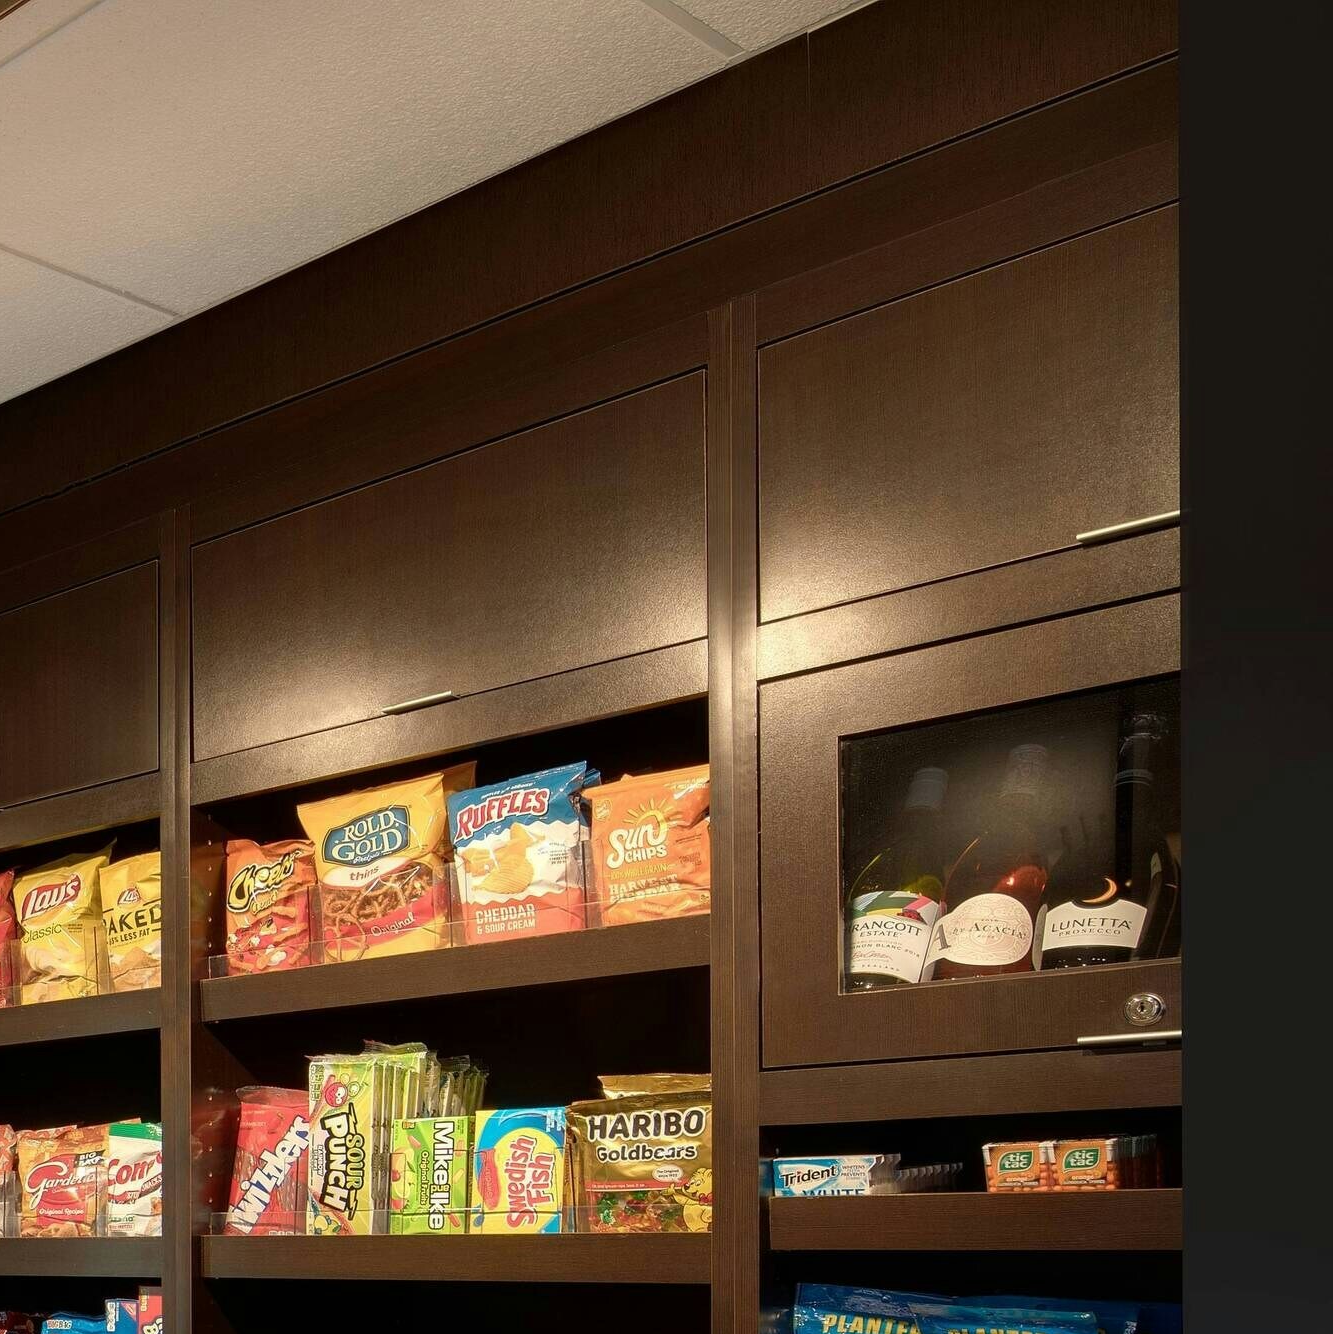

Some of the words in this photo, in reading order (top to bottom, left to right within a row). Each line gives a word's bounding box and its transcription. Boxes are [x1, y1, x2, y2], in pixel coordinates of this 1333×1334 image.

[455, 789, 550, 841] RUFFLES
[344, 811, 395, 843] ROLD
[331, 828, 393, 863] GOLD
[624, 845, 667, 863] CHIPS
[350, 866, 379, 881] thins
[23, 877, 79, 922] Lay's
[371, 912, 415, 937] Original
[475, 904, 536, 925] CHEDDAR
[1052, 917, 1131, 933] LUNETTA
[120, 932, 137, 942] LESS
[139, 927, 150, 937] FAT
[485, 921, 506, 935] SOUR
[507, 918, 536, 932] CREAM
[853, 920, 923, 937] RANCOTT
[859, 929, 900, 938] ESTATE
[973, 922, 1026, 940] ACACIA
[1058, 927, 1122, 938] PROSECCO
[587, 1108, 705, 1141] HARIBO
[323, 1113, 349, 1211] PUNCH
[346, 1134, 365, 1190] SOUR
[433, 1121, 454, 1185] Mike
[596, 1143, 698, 1163] Goldbears
[1009, 1152, 1029, 1162] tic
[1069, 1157, 1094, 1167] tac
[1074, 1150, 1095, 1159] tic
[421, 1151, 429, 1183] Original
[1004, 1159, 1028, 1169] tac
[506, 1136, 536, 1228] Swedish
[526, 1154, 555, 1207] Fish
[781, 1164, 838, 1187] Trident
[420, 1183, 428, 1205] Fruits
[428, 1192, 450, 1230] Ike
